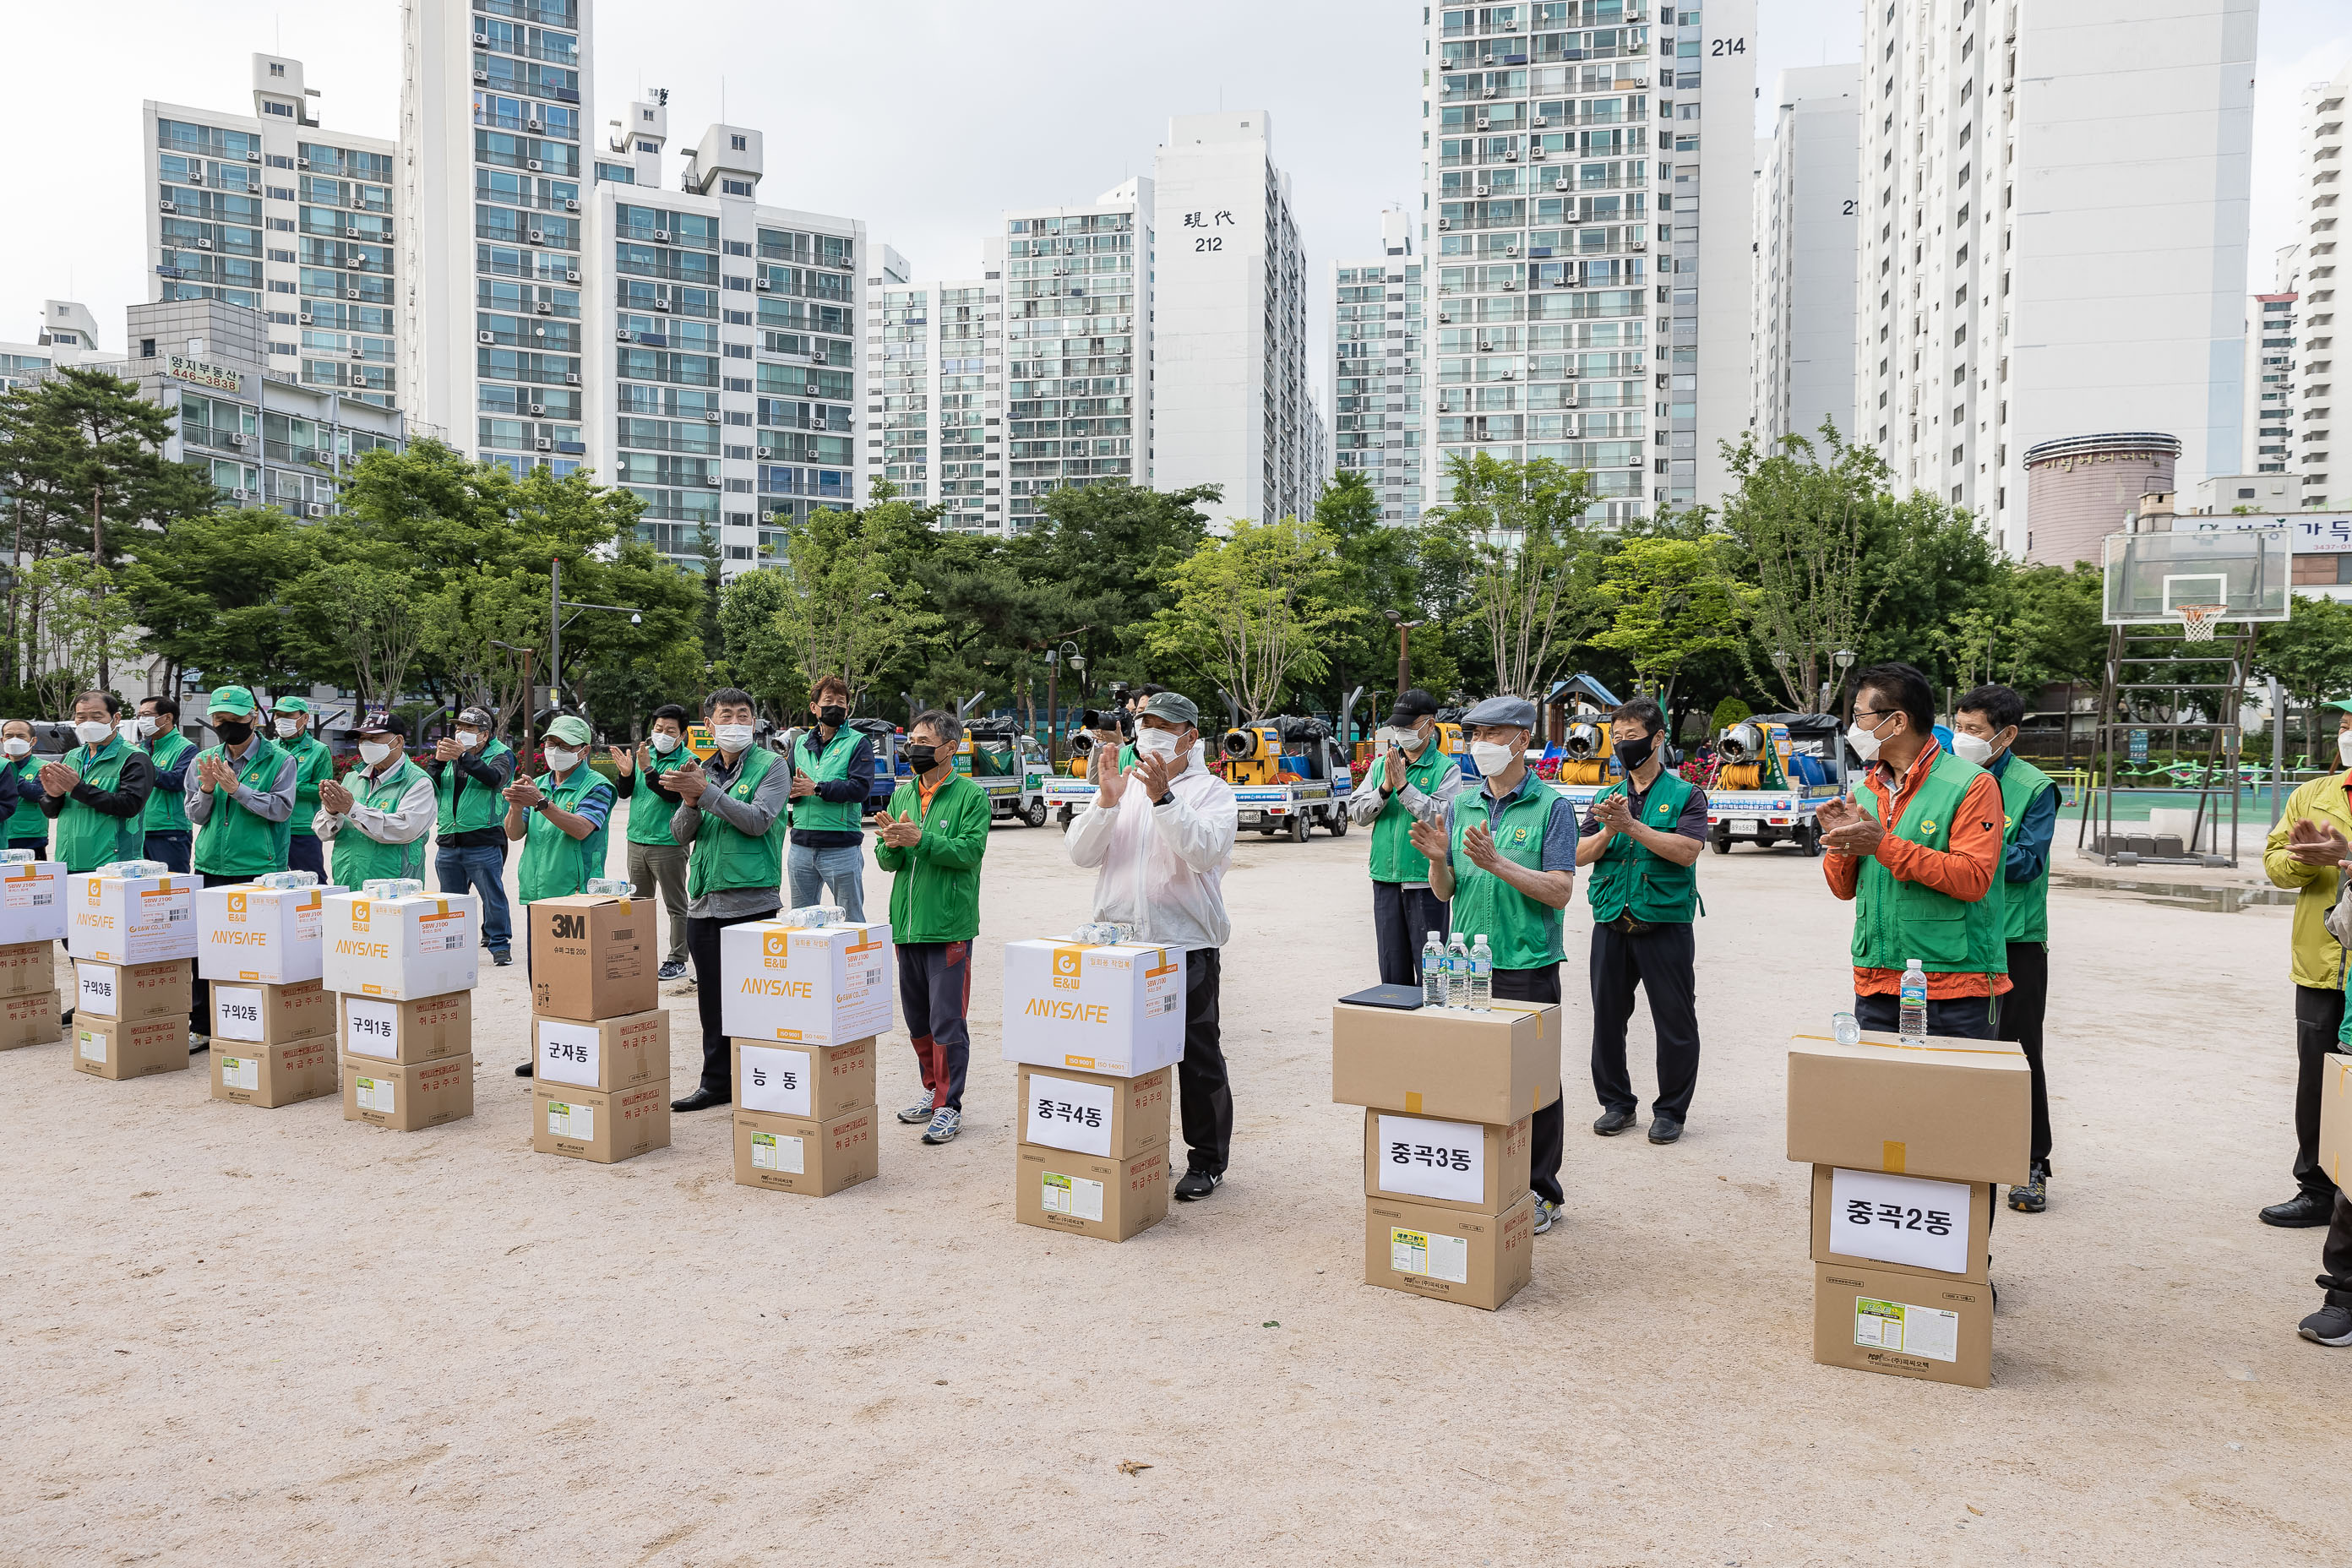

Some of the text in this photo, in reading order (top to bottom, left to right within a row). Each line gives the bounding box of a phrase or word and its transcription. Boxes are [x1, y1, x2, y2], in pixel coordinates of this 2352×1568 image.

[1712, 37, 1745, 57] 214
[1184, 210, 1235, 228] 現代
[1195, 237, 1222, 252] 212
[172, 356, 237, 382] 양지부동산
[172, 368, 237, 390] 446-3838
[2298, 520, 2351, 542] 가득
[77, 912, 115, 928] ANYSAFE
[228, 913, 247, 923] E&W
[552, 913, 585, 939] 3M
[352, 923, 370, 932] E&W
[211, 930, 267, 946] ANYSAFE
[335, 939, 389, 959] ANYSAFE
[554, 946, 564, 955] 슈퍼
[564, 947, 575, 956] 그립
[764, 958, 787, 968] E&W
[83, 980, 112, 997] 구의3동
[741, 977, 813, 999] ANYSAFE
[1054, 977, 1080, 989] E&W
[221, 1004, 258, 1021] 구의2동
[418, 1011, 458, 1026] 취급주의
[1025, 999, 1108, 1024] ANYSAFE
[353, 1017, 391, 1037] 구의1동
[622, 1033, 656, 1049] 취급주의
[549, 1042, 588, 1063] 군자동
[832, 1058, 864, 1076] 취급주의
[1108, 1062, 1124, 1070] 14001
[422, 1076, 460, 1092] 취급주의
[1135, 1090, 1162, 1109] 취급주의
[624, 1102, 658, 1120] 취급주의
[1037, 1098, 1102, 1128] 중곡4동
[835, 1131, 867, 1151] 취급주의
[1391, 1141, 1472, 1172] 중곡3동
[1131, 1170, 1160, 1191] 취급주의
[1846, 1199, 1952, 1236] 중곡2동
[1892, 1357, 1930, 1369] (주)피씨오텍
